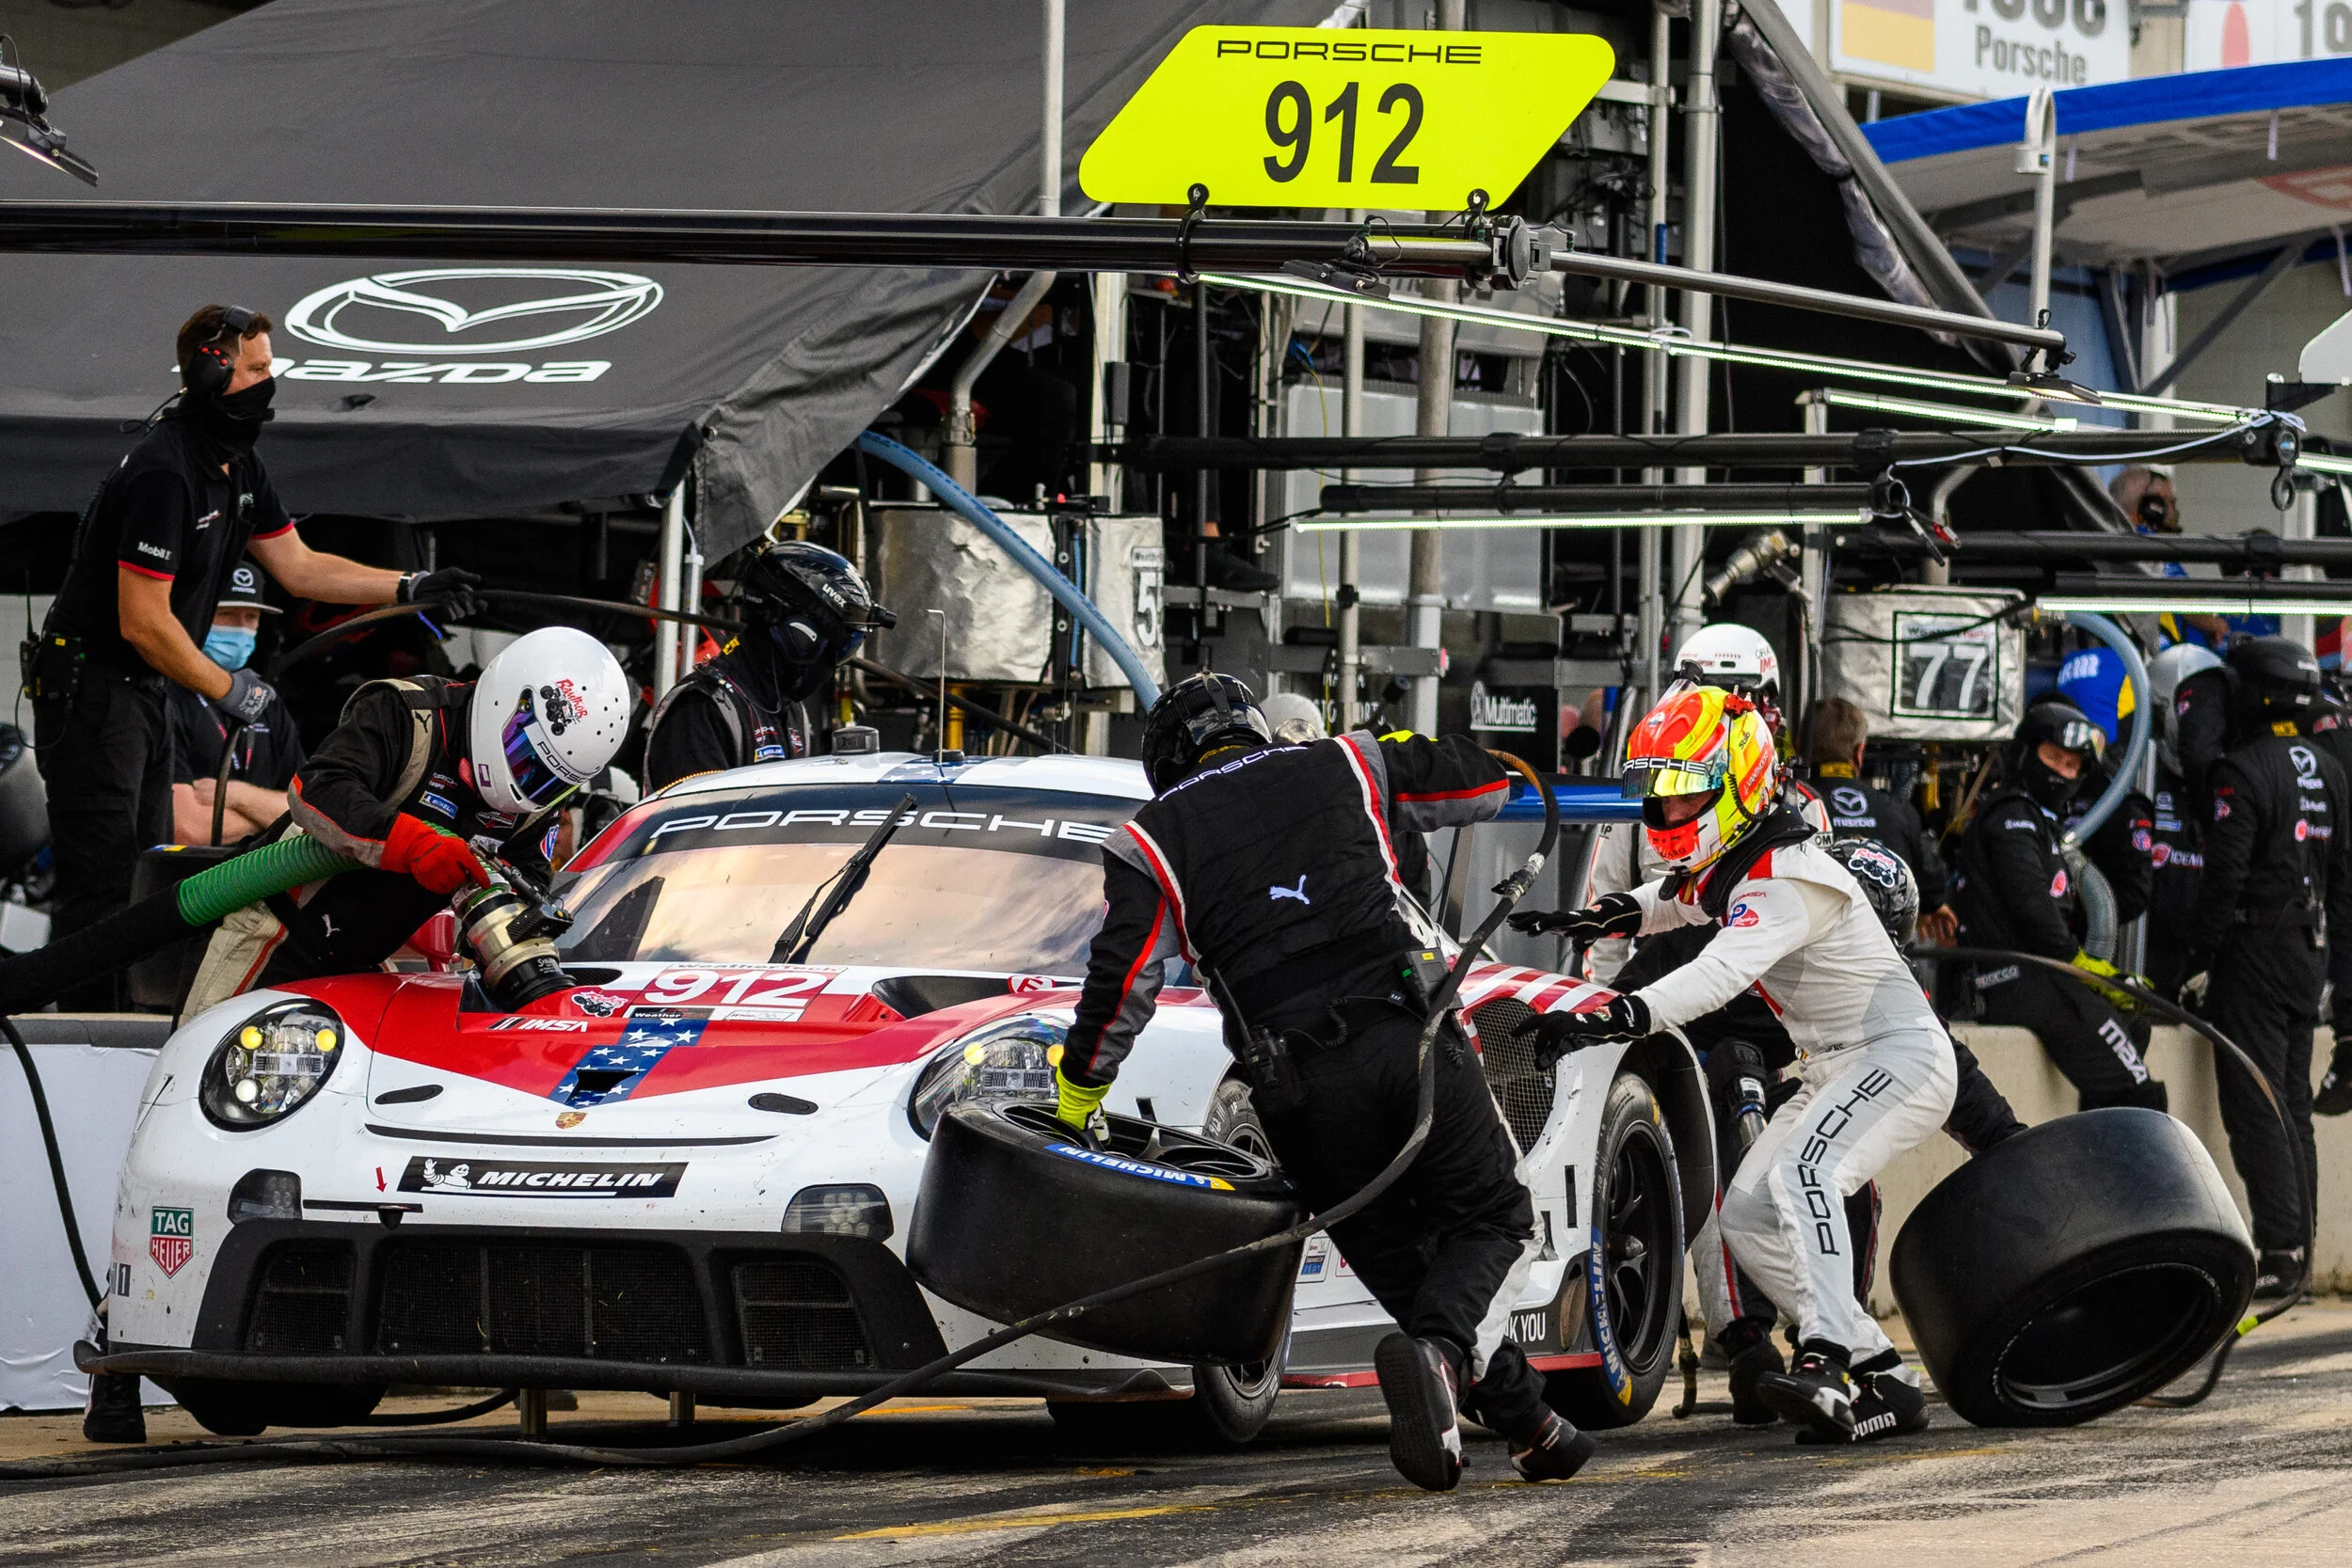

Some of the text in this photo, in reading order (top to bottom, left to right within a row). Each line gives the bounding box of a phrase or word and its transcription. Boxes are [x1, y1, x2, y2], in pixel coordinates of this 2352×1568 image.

[1216, 40, 1483, 64] PORSCHE
[1975, 24, 2087, 85] Porsche
[1263, 80, 1424, 184] 912
[137, 542, 165, 559] Mobil
[822, 583, 848, 608] uvex
[1136, 572, 1164, 649] 5
[1909, 645, 1987, 709] 77
[1485, 695, 1536, 725] Multimatic
[650, 810, 1117, 844] PORSCHE
[644, 970, 827, 1006] 912
[517, 1019, 589, 1033] IMSA
[476, 1171, 664, 1187] MICHELIN
[1058, 1146, 1188, 1182] MICHELIN
[1797, 1069, 1894, 1256] PORSCHE
[154, 1212, 189, 1234] TAG
[151, 1239, 191, 1273] HEUER
[1591, 1241, 1621, 1375] MICHELIN
[1521, 1312, 1546, 1342] YOU
[1851, 1412, 1897, 1442] PUMA
